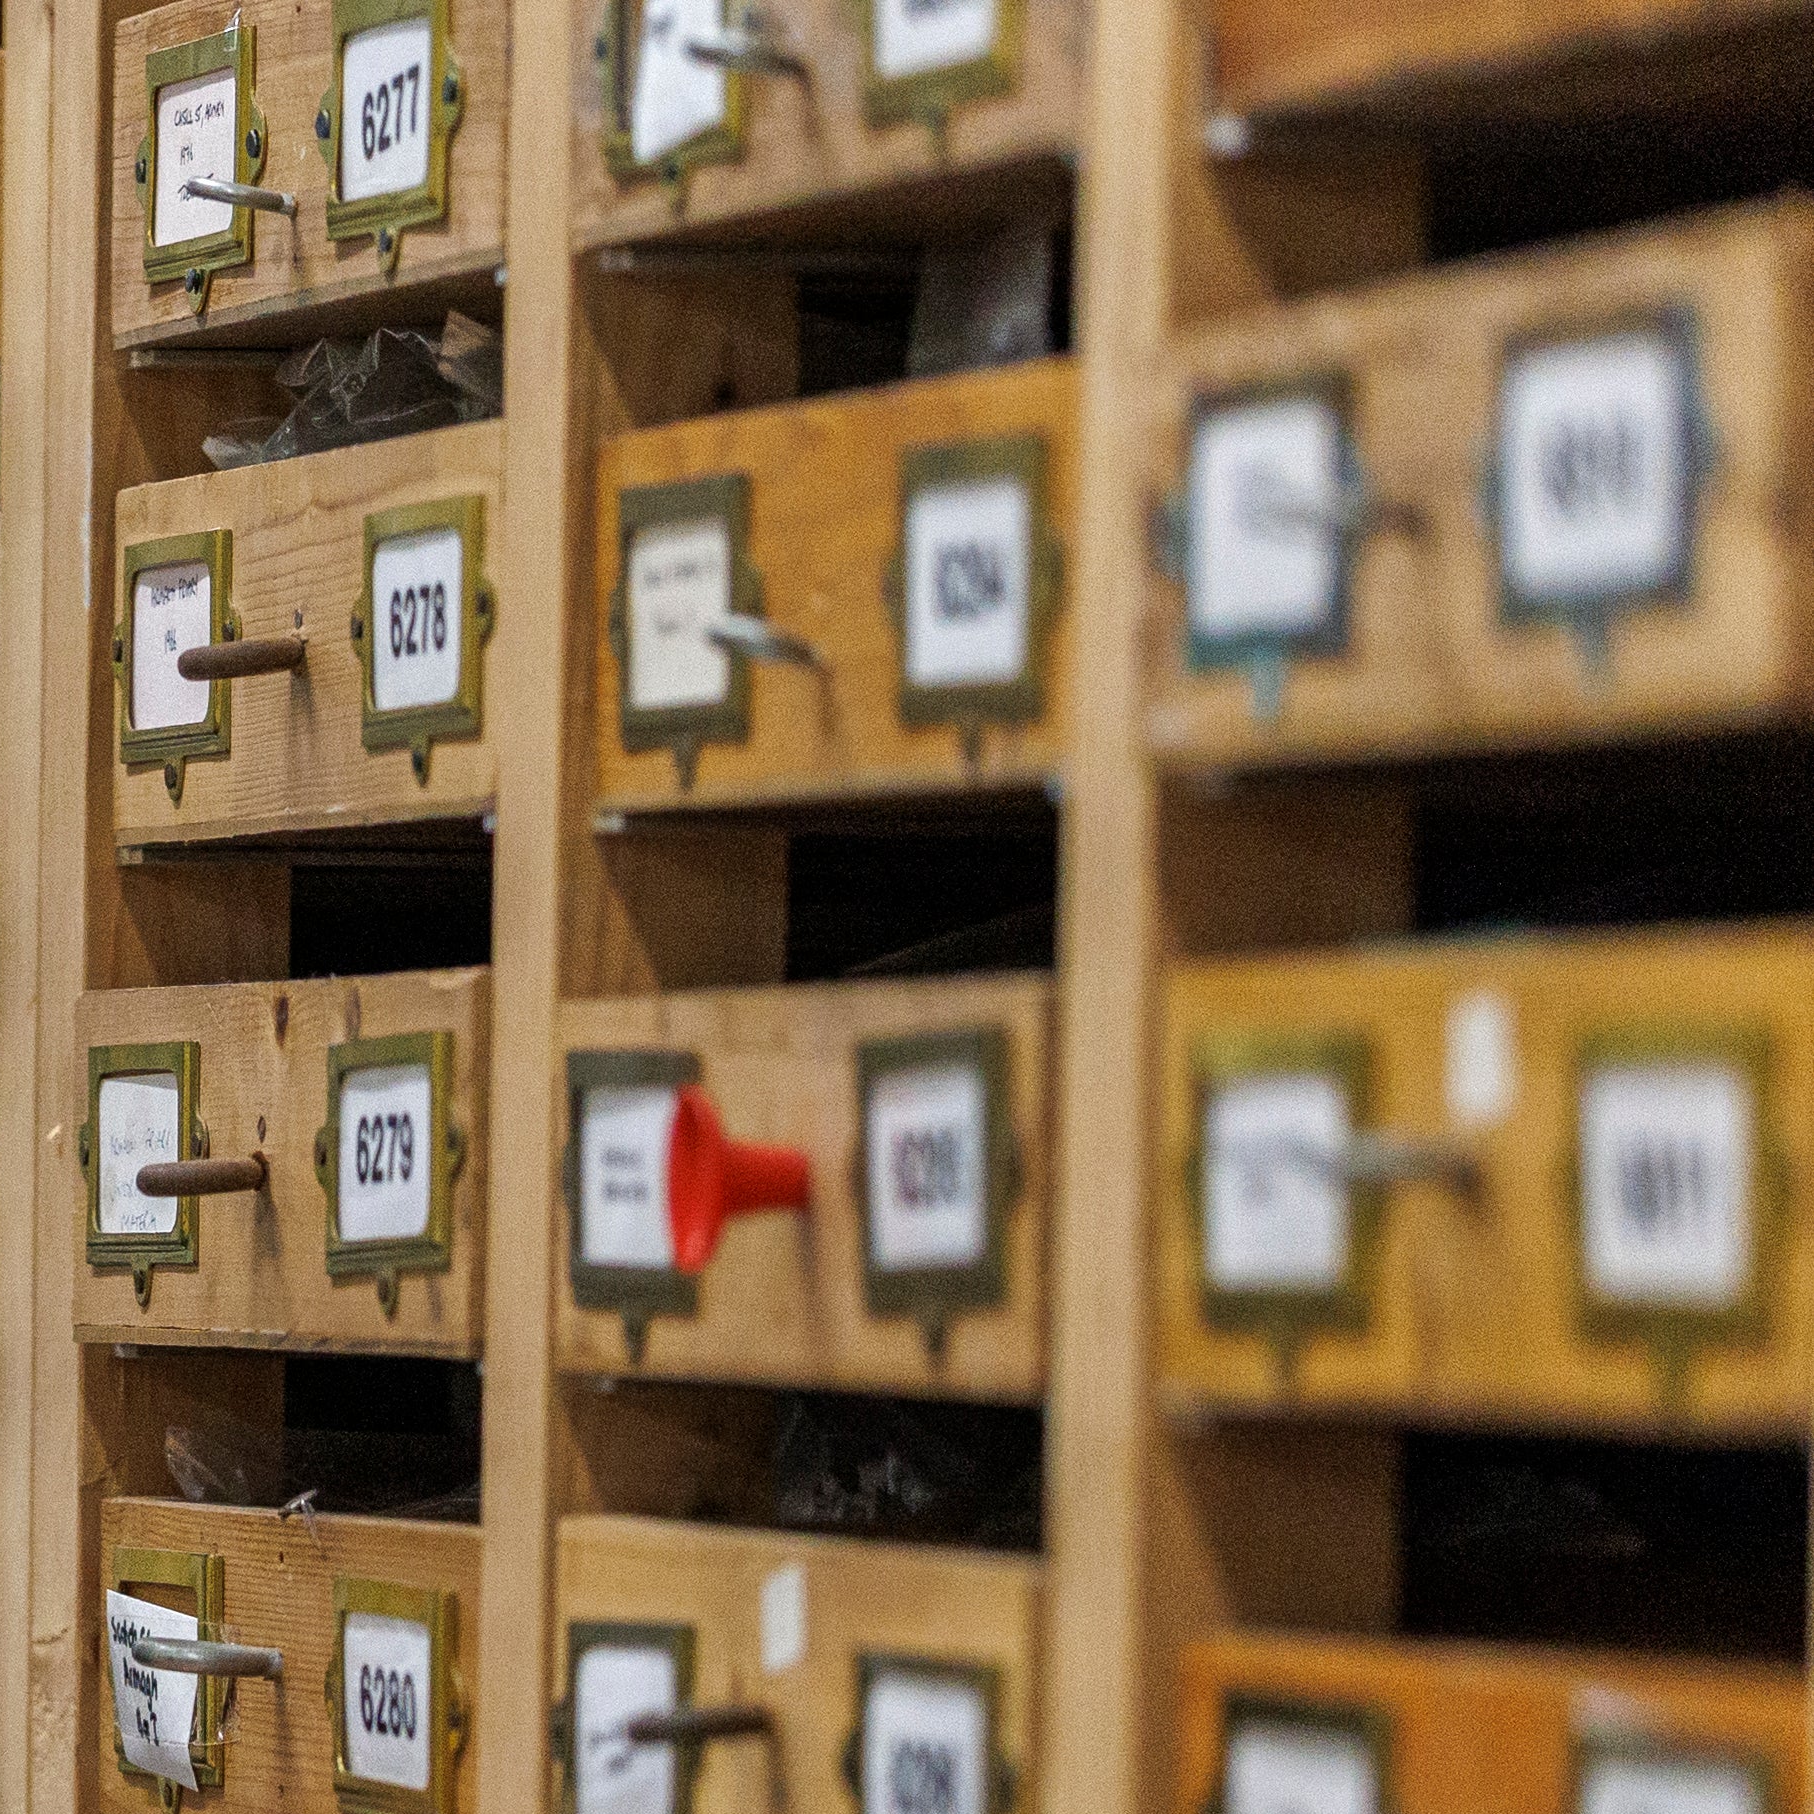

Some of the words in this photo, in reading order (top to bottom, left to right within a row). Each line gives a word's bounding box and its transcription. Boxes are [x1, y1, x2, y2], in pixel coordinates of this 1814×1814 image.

[362, 63, 420, 161] 6277
[390, 580, 447, 660] 6278
[355, 1112, 415, 1186] 6279
[359, 1663, 418, 1741] 6280
